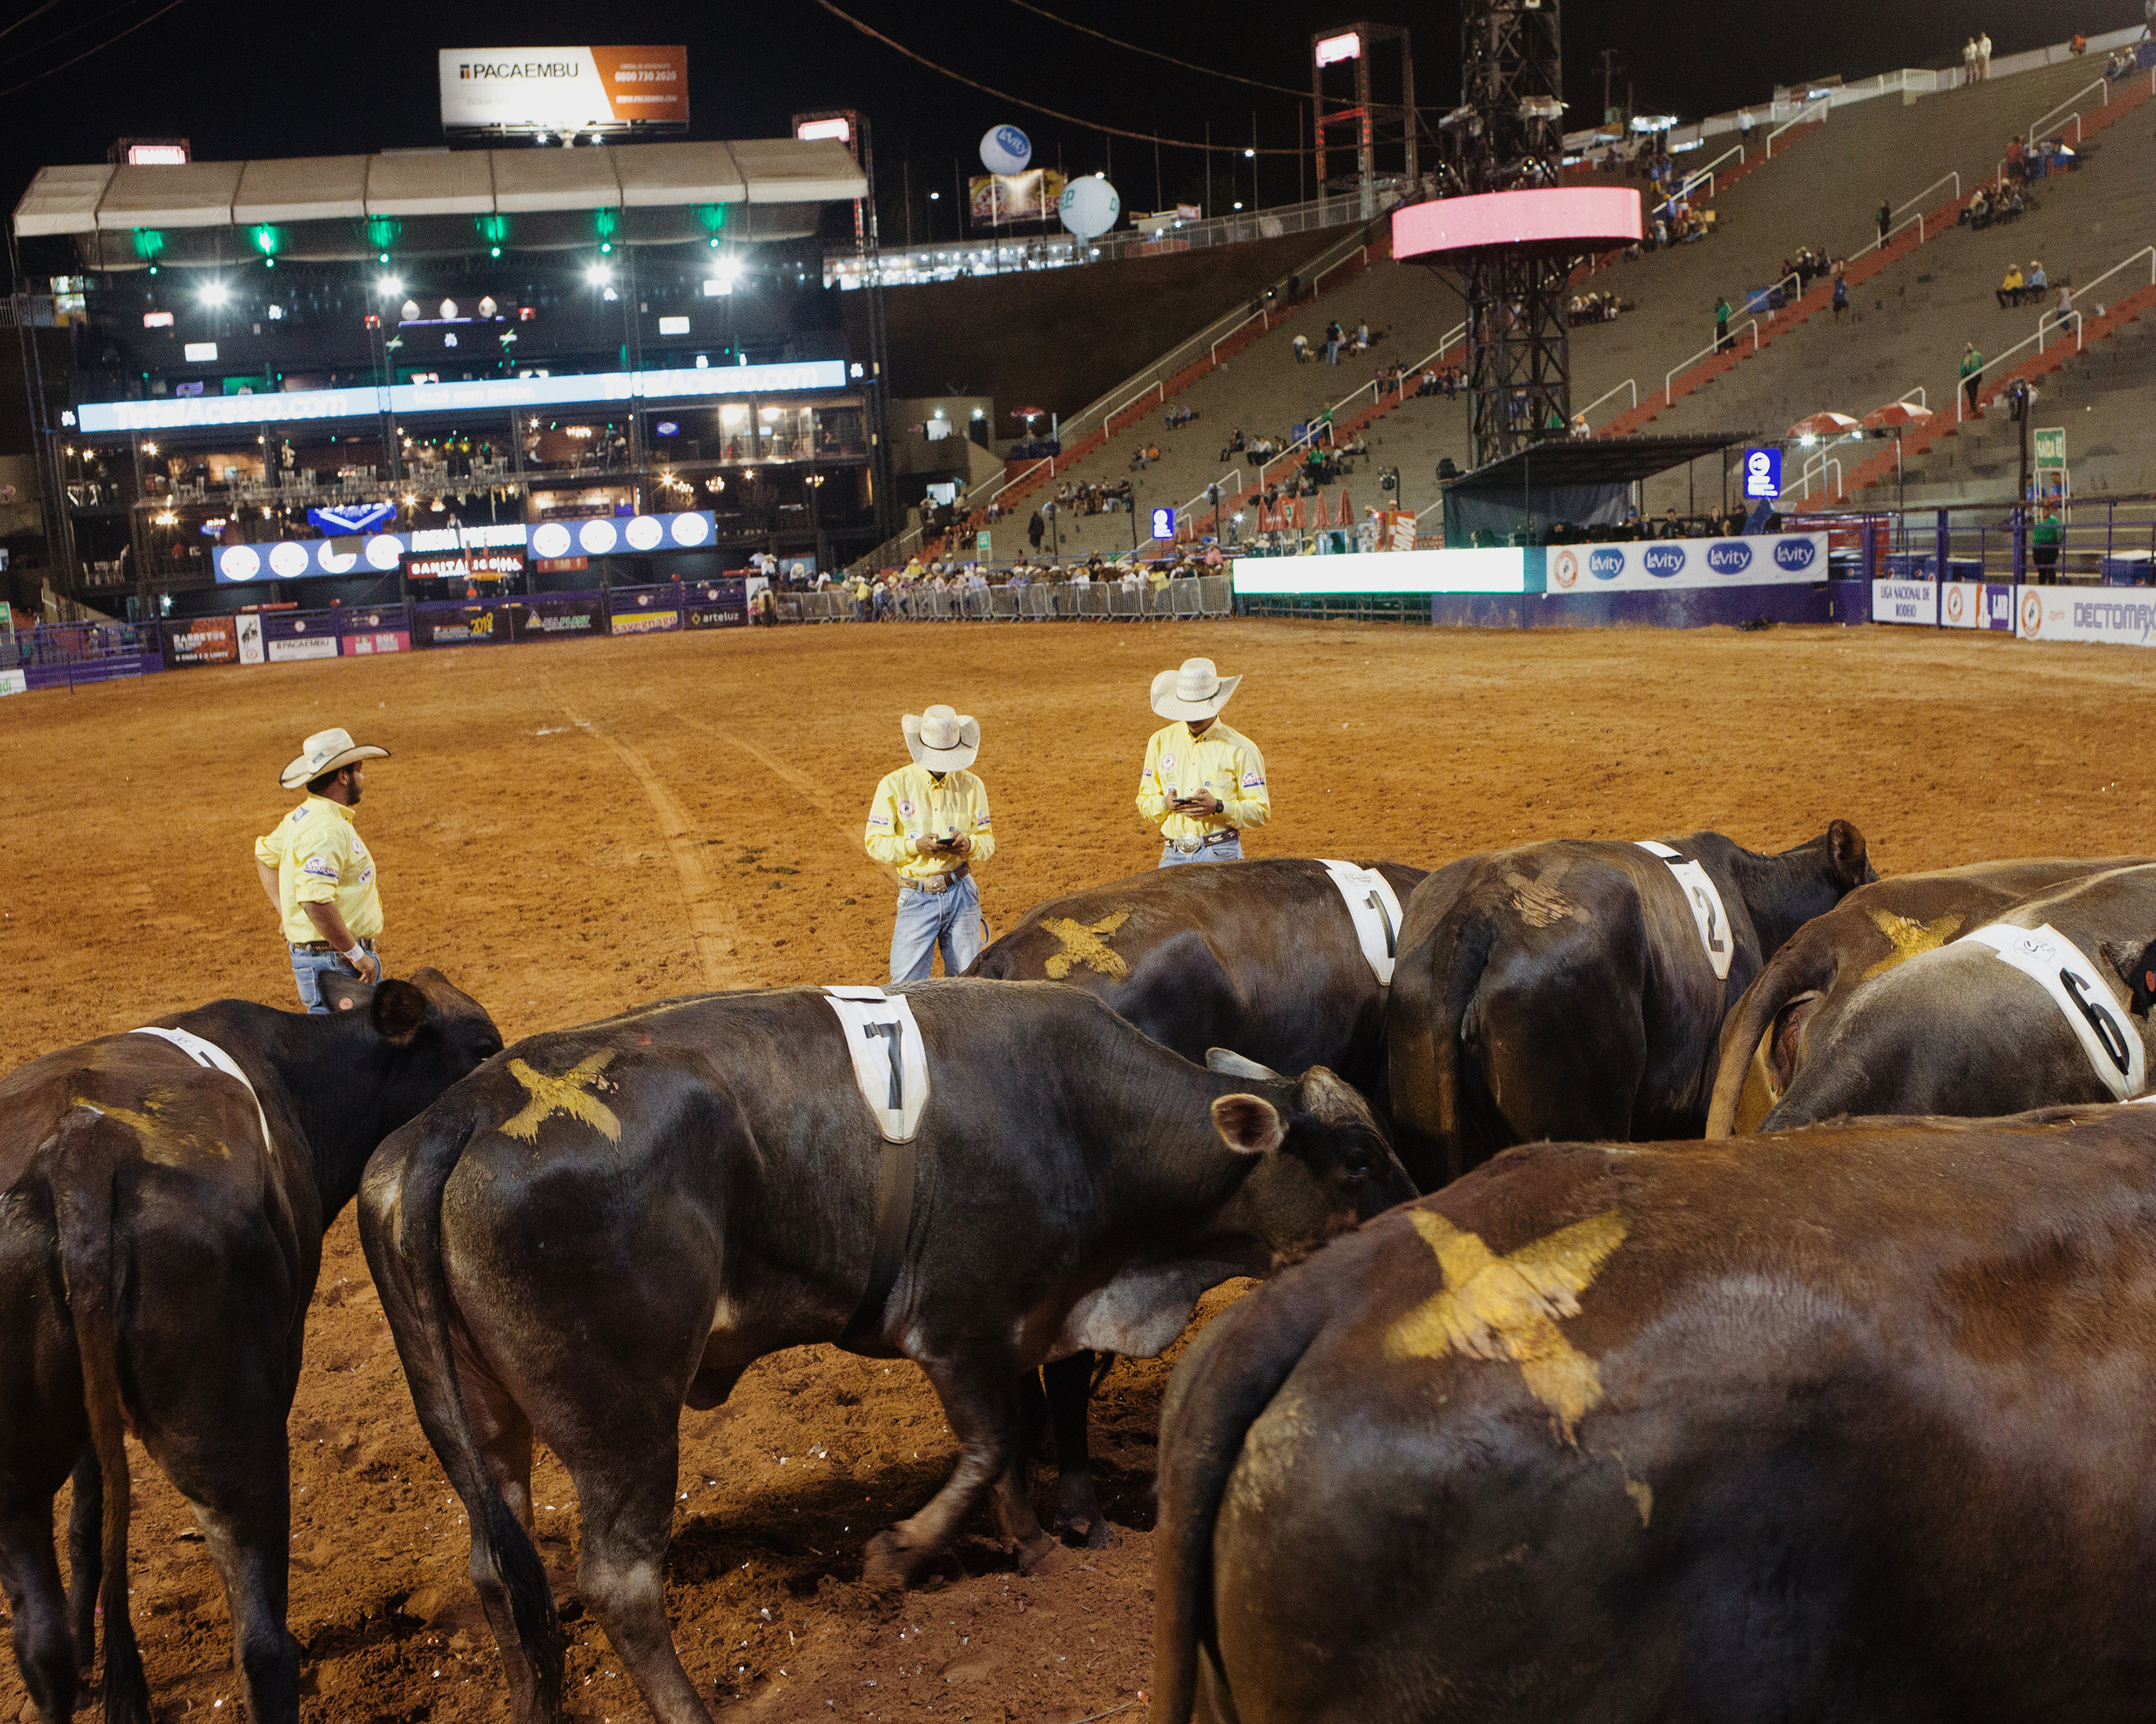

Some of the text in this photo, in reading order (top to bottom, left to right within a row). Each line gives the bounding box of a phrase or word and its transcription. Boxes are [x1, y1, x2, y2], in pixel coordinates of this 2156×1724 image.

[474, 62, 579, 79] PACAEMBU
[452, 390, 484, 403] sem
[601, 367, 818, 399] TotalAcesso.com
[112, 394, 347, 430] TotalAcesso.com
[702, 612, 739, 623] arteluz
[1362, 890, 1396, 958] 1
[1692, 886, 1724, 952] 2
[2059, 967, 2130, 1076] 6
[863, 1020, 903, 1110] 7
